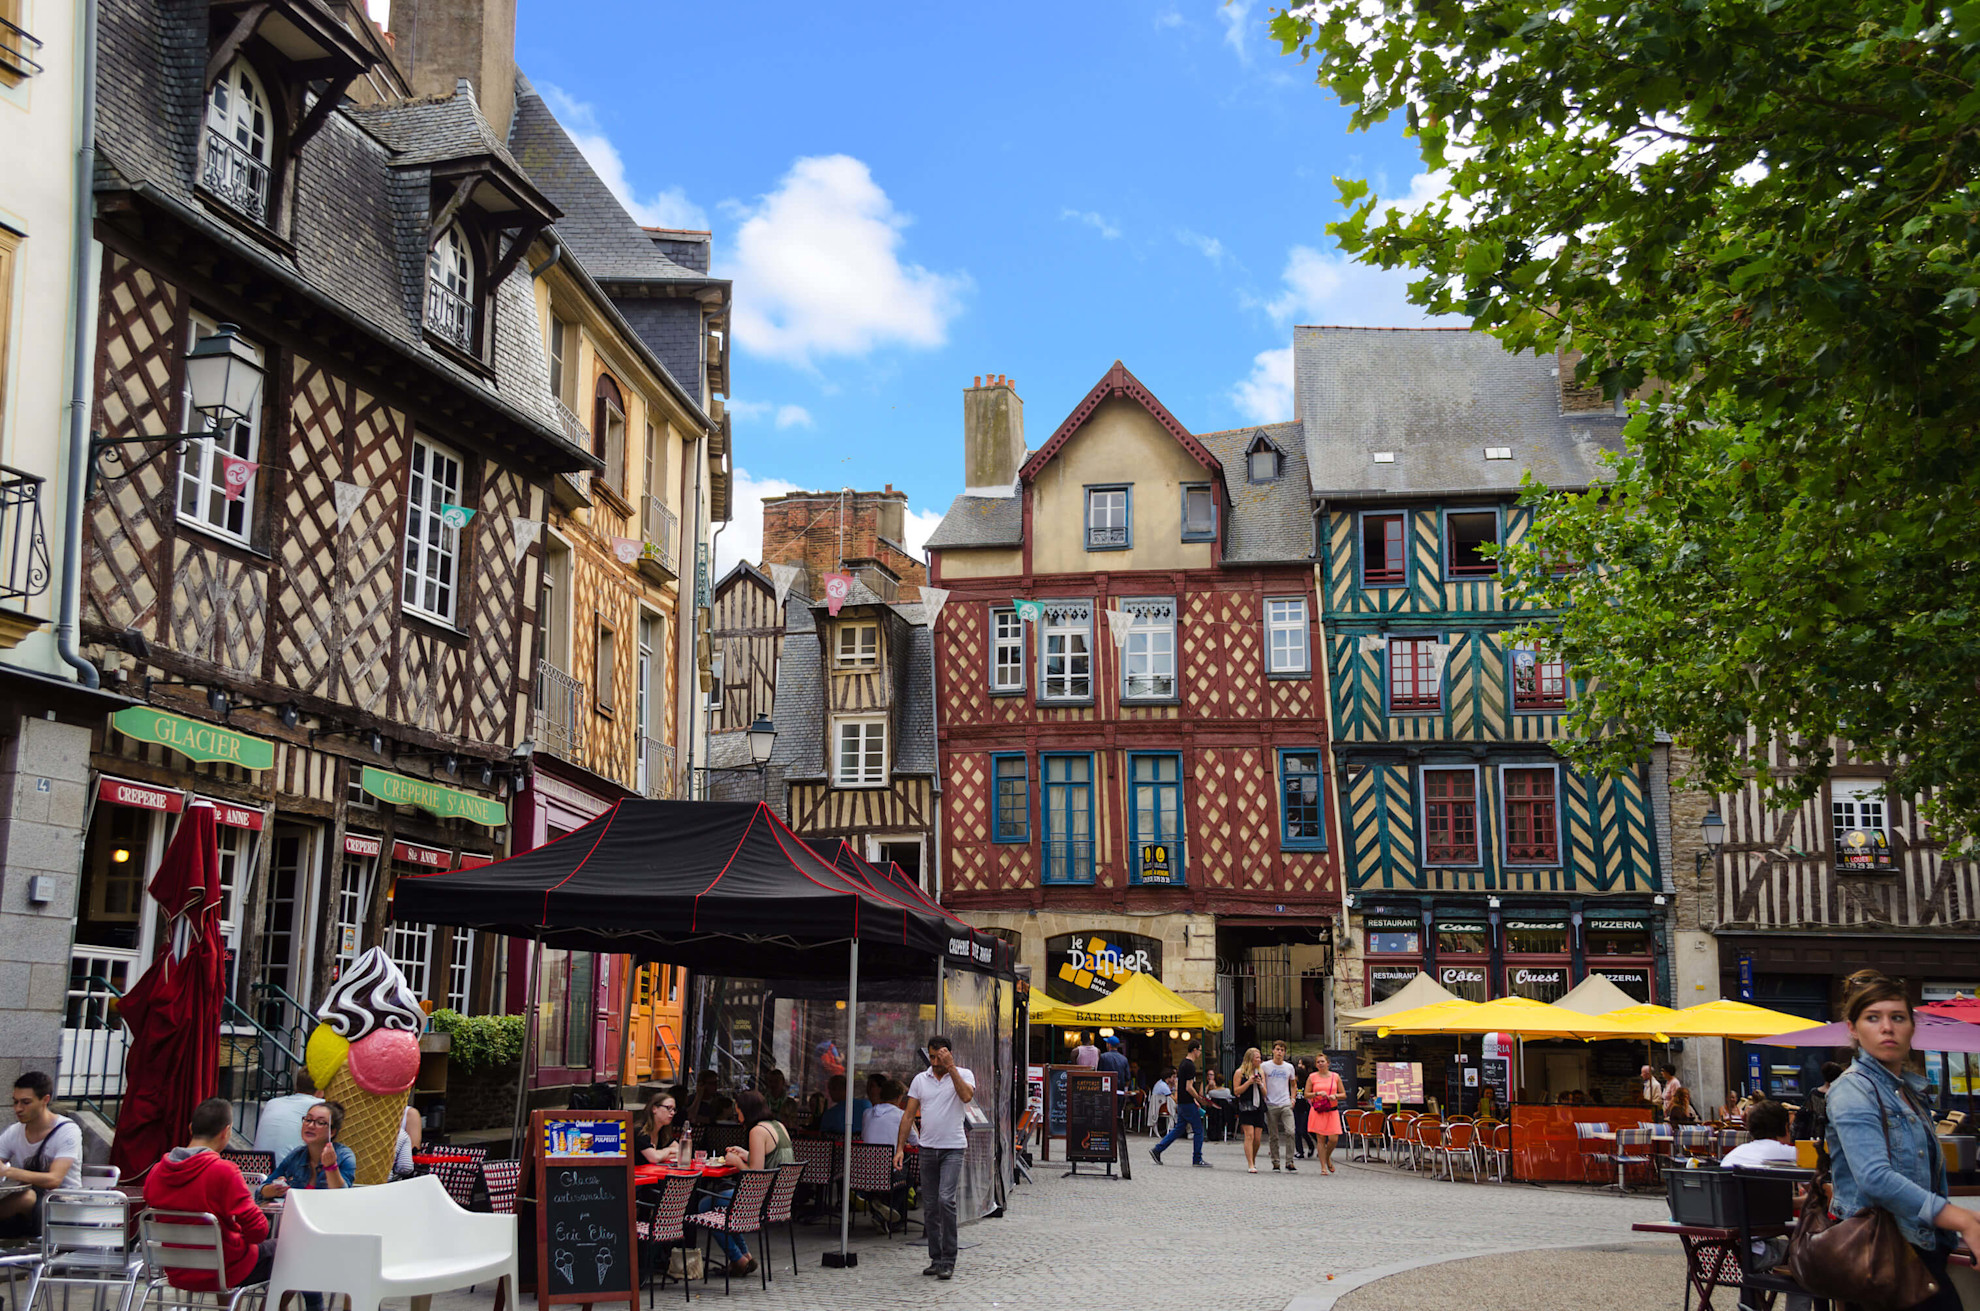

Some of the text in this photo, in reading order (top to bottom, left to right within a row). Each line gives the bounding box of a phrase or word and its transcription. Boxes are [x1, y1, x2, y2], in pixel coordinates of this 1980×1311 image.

[155, 717, 241, 760] GLACIER
[38, 779, 48, 791] 4
[118, 786, 167, 809] CREPERIE
[384, 777, 440, 808] CREPERIE
[458, 801, 489, 820] ANNE
[226, 809, 250, 826] ANNE
[346, 837, 379, 855] CREPERIE
[407, 847, 438, 865] Ste ANNE
[1376, 905, 1385, 914] 10
[1368, 919, 1417, 927] RESTAURANT
[1438, 923, 1483, 931] Côte
[1506, 921, 1565, 929] Ouest
[1591, 920, 1643, 929] PIZZERIA
[1071, 935, 1083, 950] le
[1093, 977, 1106, 987] BAR
[1373, 972, 1416, 980] RESTAURANT
[1443, 969, 1483, 984] Côte
[1515, 969, 1559, 984] Ouest
[1076, 1011, 1183, 1024] BAR BRASSERIE
